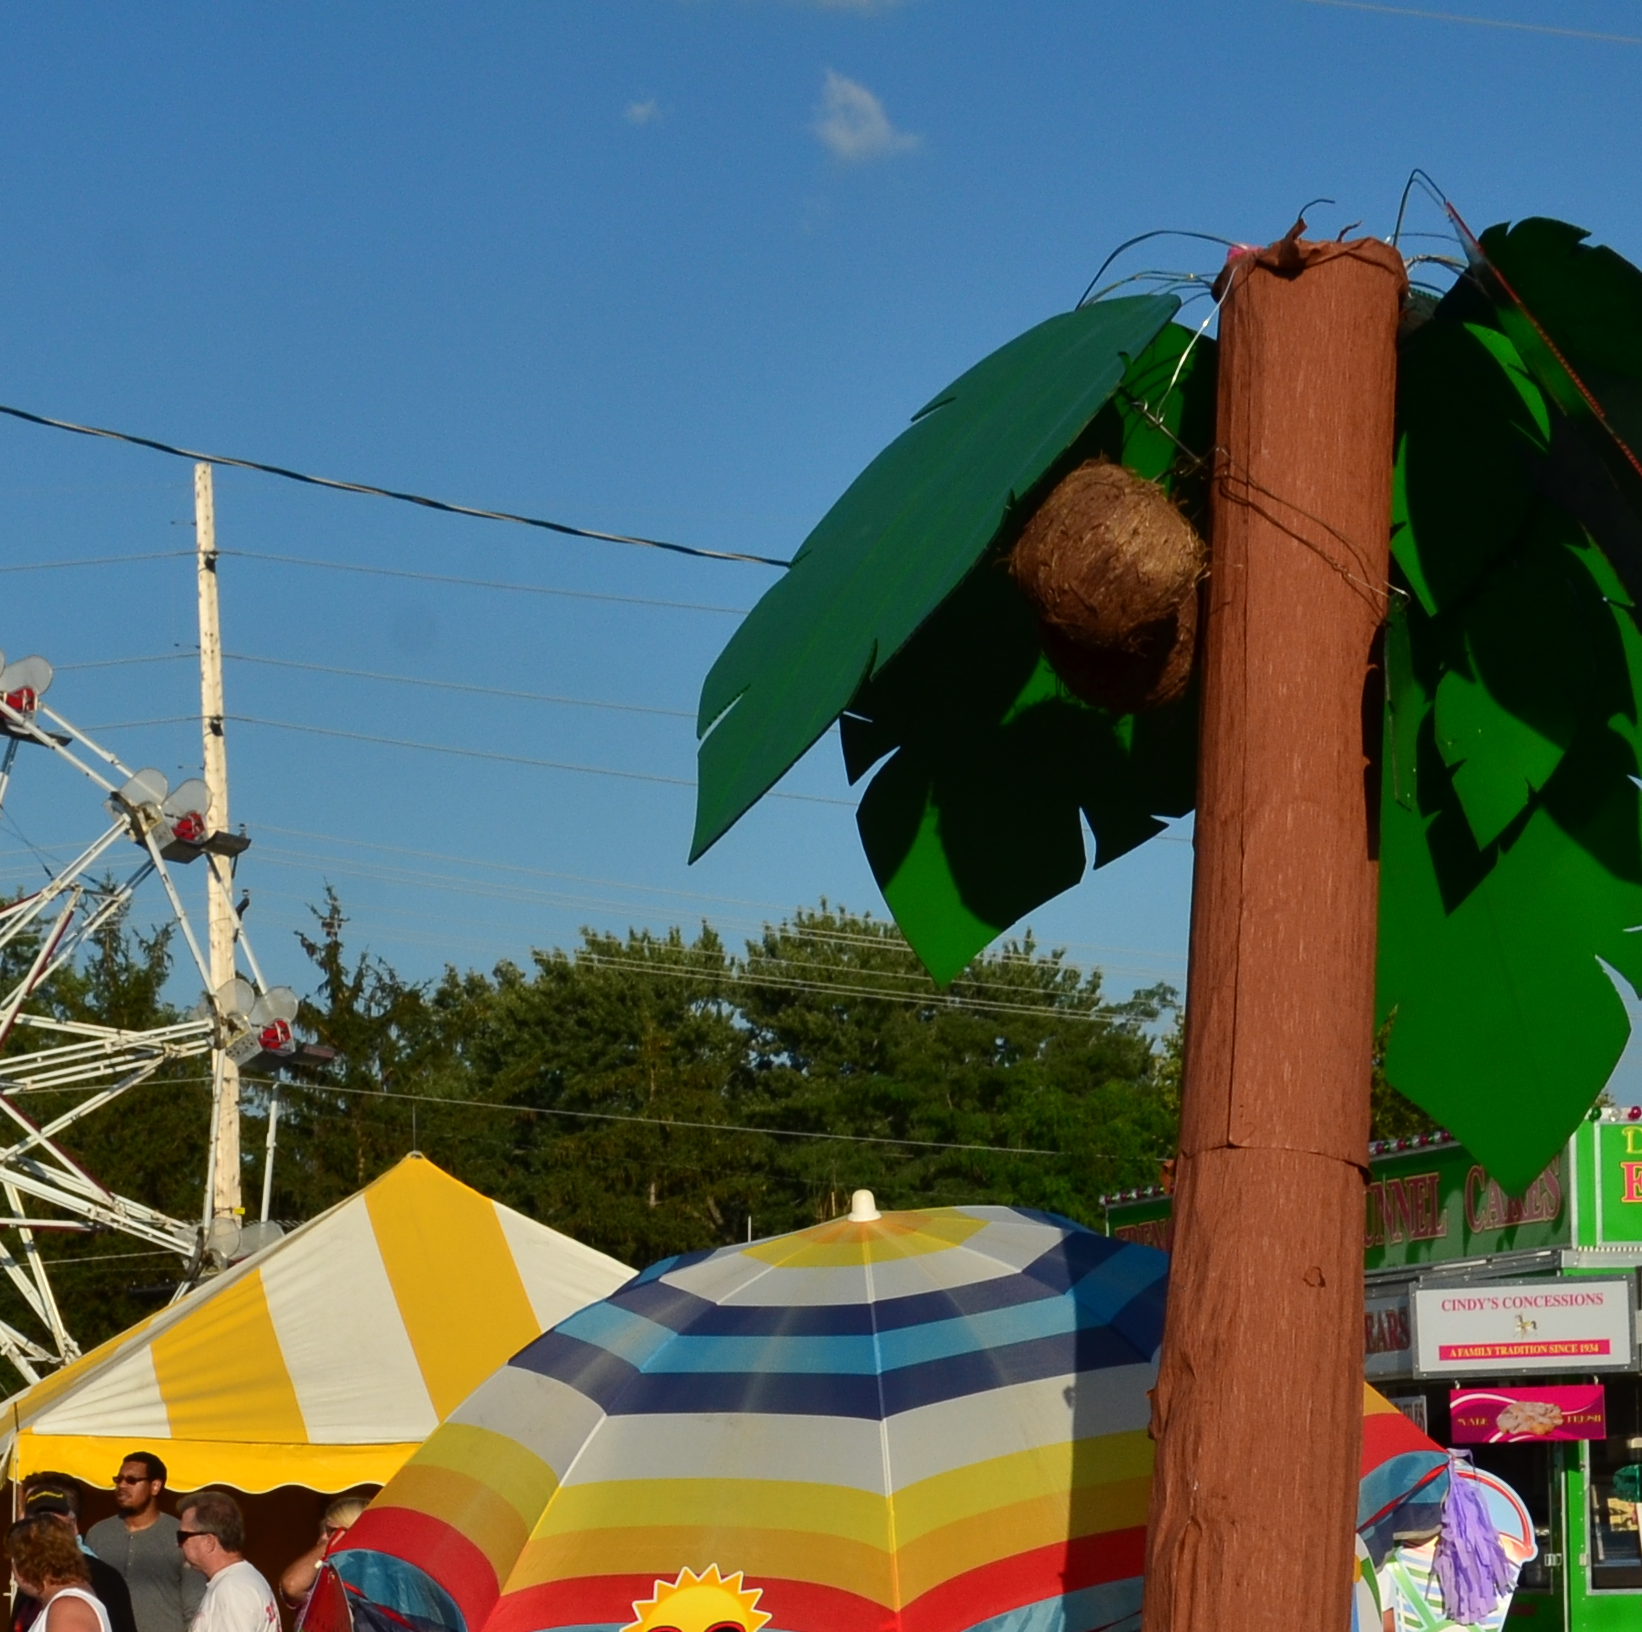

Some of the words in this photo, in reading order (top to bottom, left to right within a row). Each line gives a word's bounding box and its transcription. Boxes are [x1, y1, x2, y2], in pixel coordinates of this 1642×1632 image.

[1364, 1172, 1448, 1248] UNNEL
[1441, 1298, 1499, 1312] CINDY'S
[1503, 1293, 1605, 1309] CONCESSIONS
[1458, 1347, 1493, 1357] FAMILY
[1494, 1345, 1547, 1356] TRADITION
[1549, 1344, 1578, 1354] SINCE
[1580, 1343, 1600, 1353] 1934
